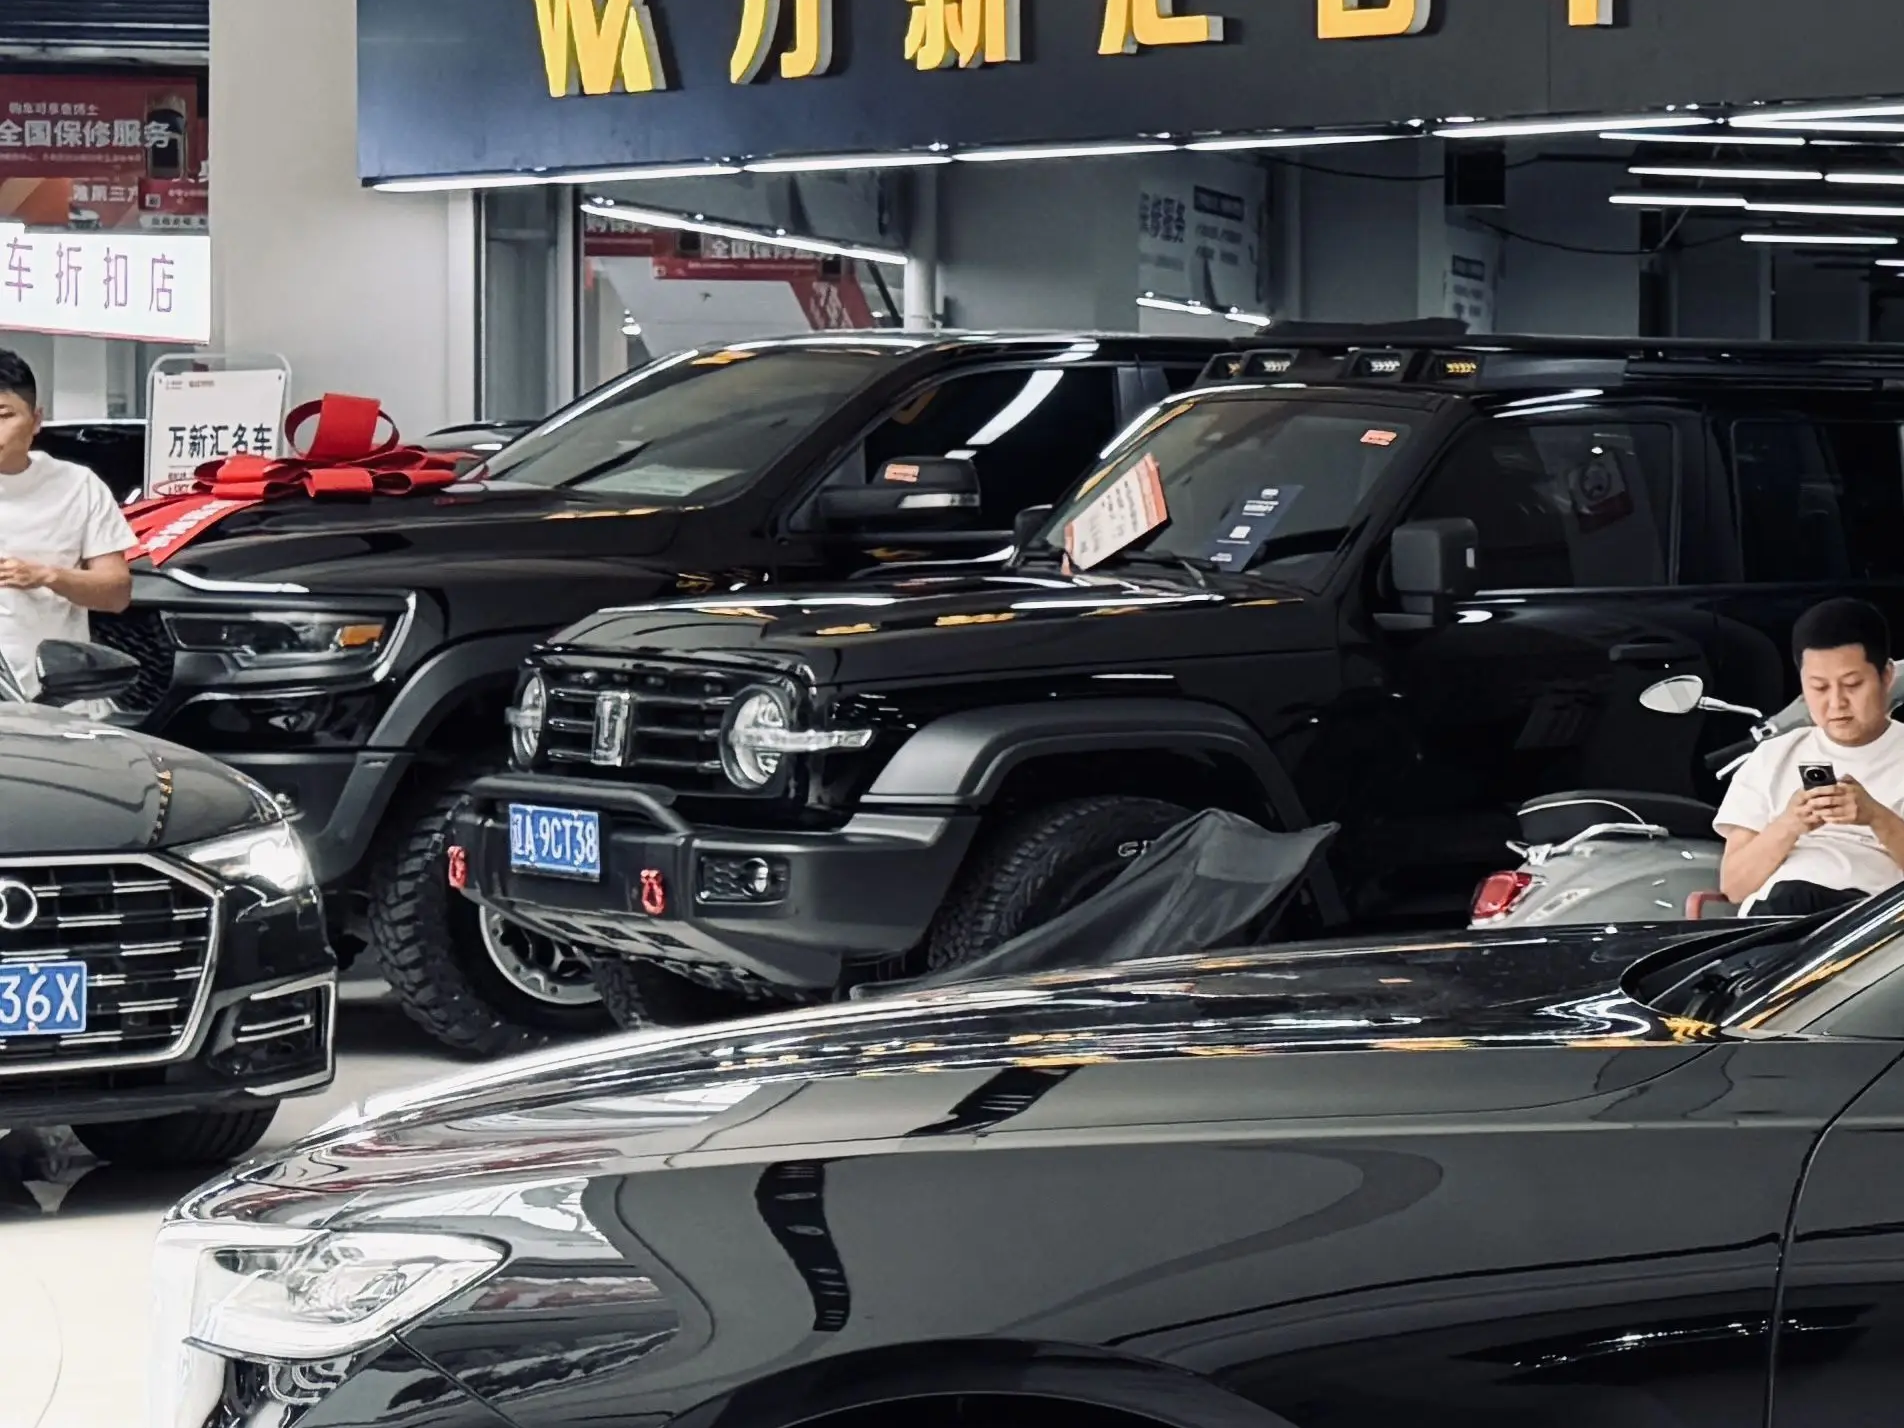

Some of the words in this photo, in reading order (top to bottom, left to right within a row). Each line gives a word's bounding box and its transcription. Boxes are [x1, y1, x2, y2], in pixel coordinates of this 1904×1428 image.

[0, 119, 172, 148] 全国保修服务
[5, 236, 175, 313] 车折扣店
[168, 423, 273, 458] 万新汇名车
